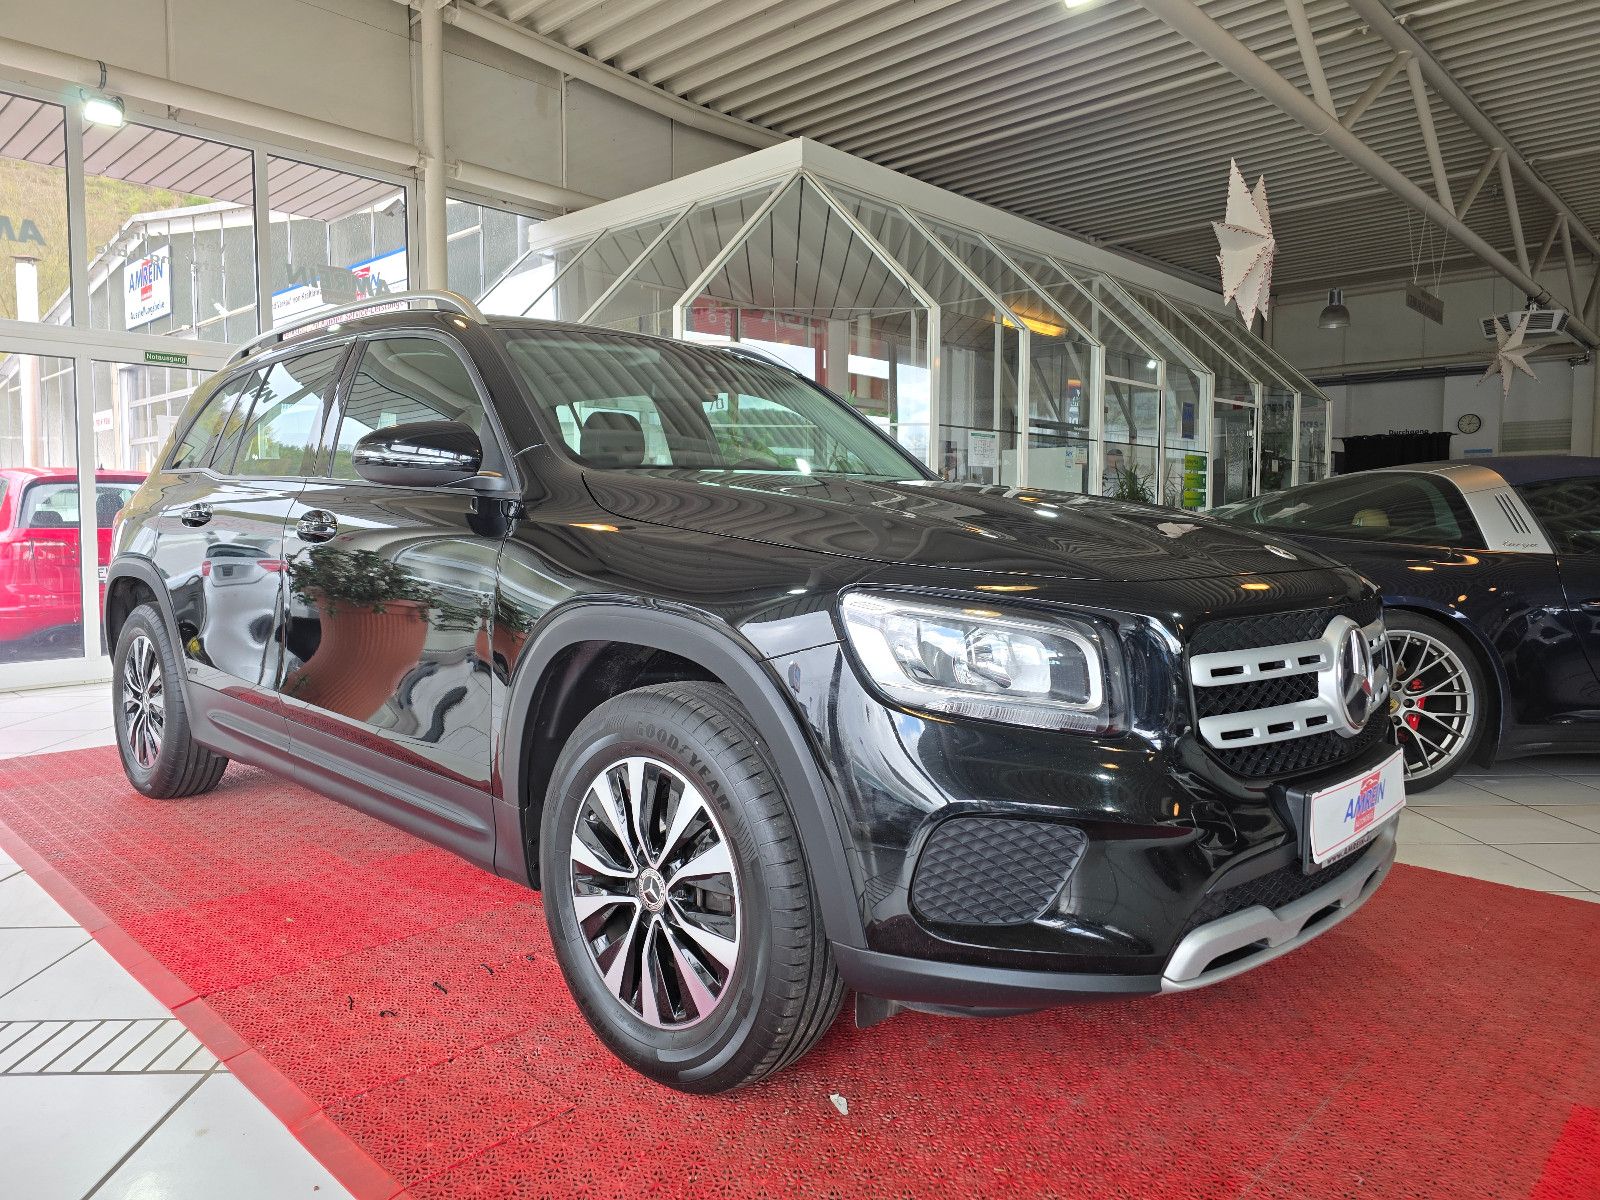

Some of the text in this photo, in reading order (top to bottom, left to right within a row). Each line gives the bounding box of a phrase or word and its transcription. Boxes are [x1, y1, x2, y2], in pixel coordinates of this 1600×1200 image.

[129, 261, 163, 293] AMREIN
[146, 352, 186, 364] Notausgang
[636, 721, 731, 811] GOODYEAR
[1344, 779, 1386, 823] AMREIN
